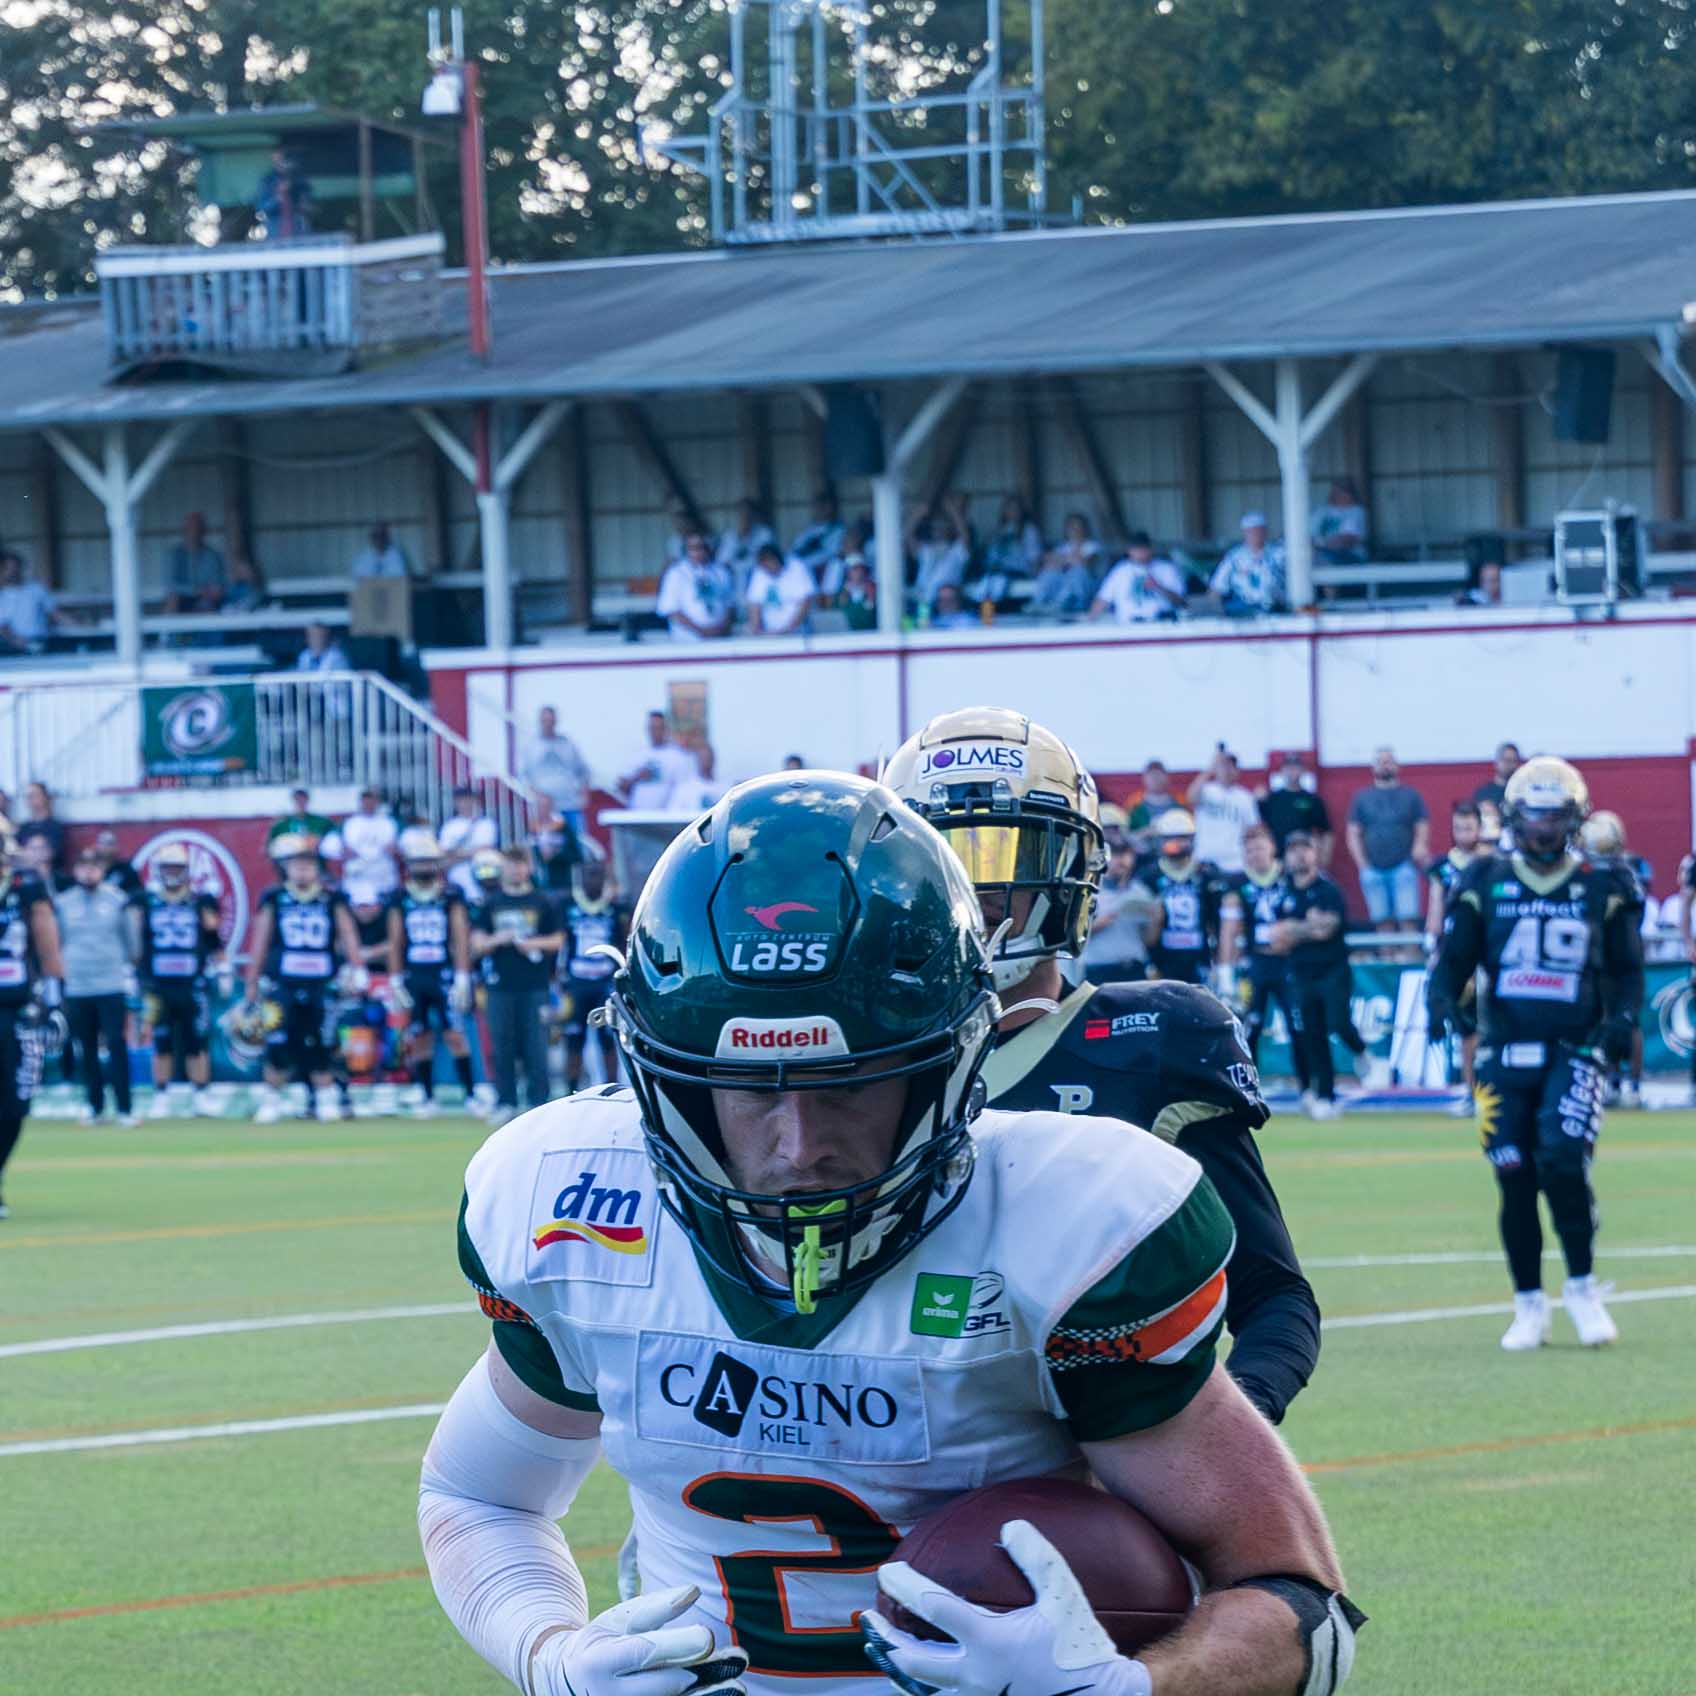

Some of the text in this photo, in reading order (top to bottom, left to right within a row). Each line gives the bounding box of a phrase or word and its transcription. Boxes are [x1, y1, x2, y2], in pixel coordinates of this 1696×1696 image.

[921, 747, 1024, 775] JOLMES
[1498, 916, 1591, 972] 49
[1111, 1012, 1161, 1031] FREY
[731, 1026, 829, 1048] Riddell
[1048, 1085, 1094, 1115] P
[552, 1171, 642, 1225] dm
[963, 1311, 1011, 1332] GFL
[660, 1363, 898, 1428] CASINO
[759, 1422, 811, 1446] KIEL
